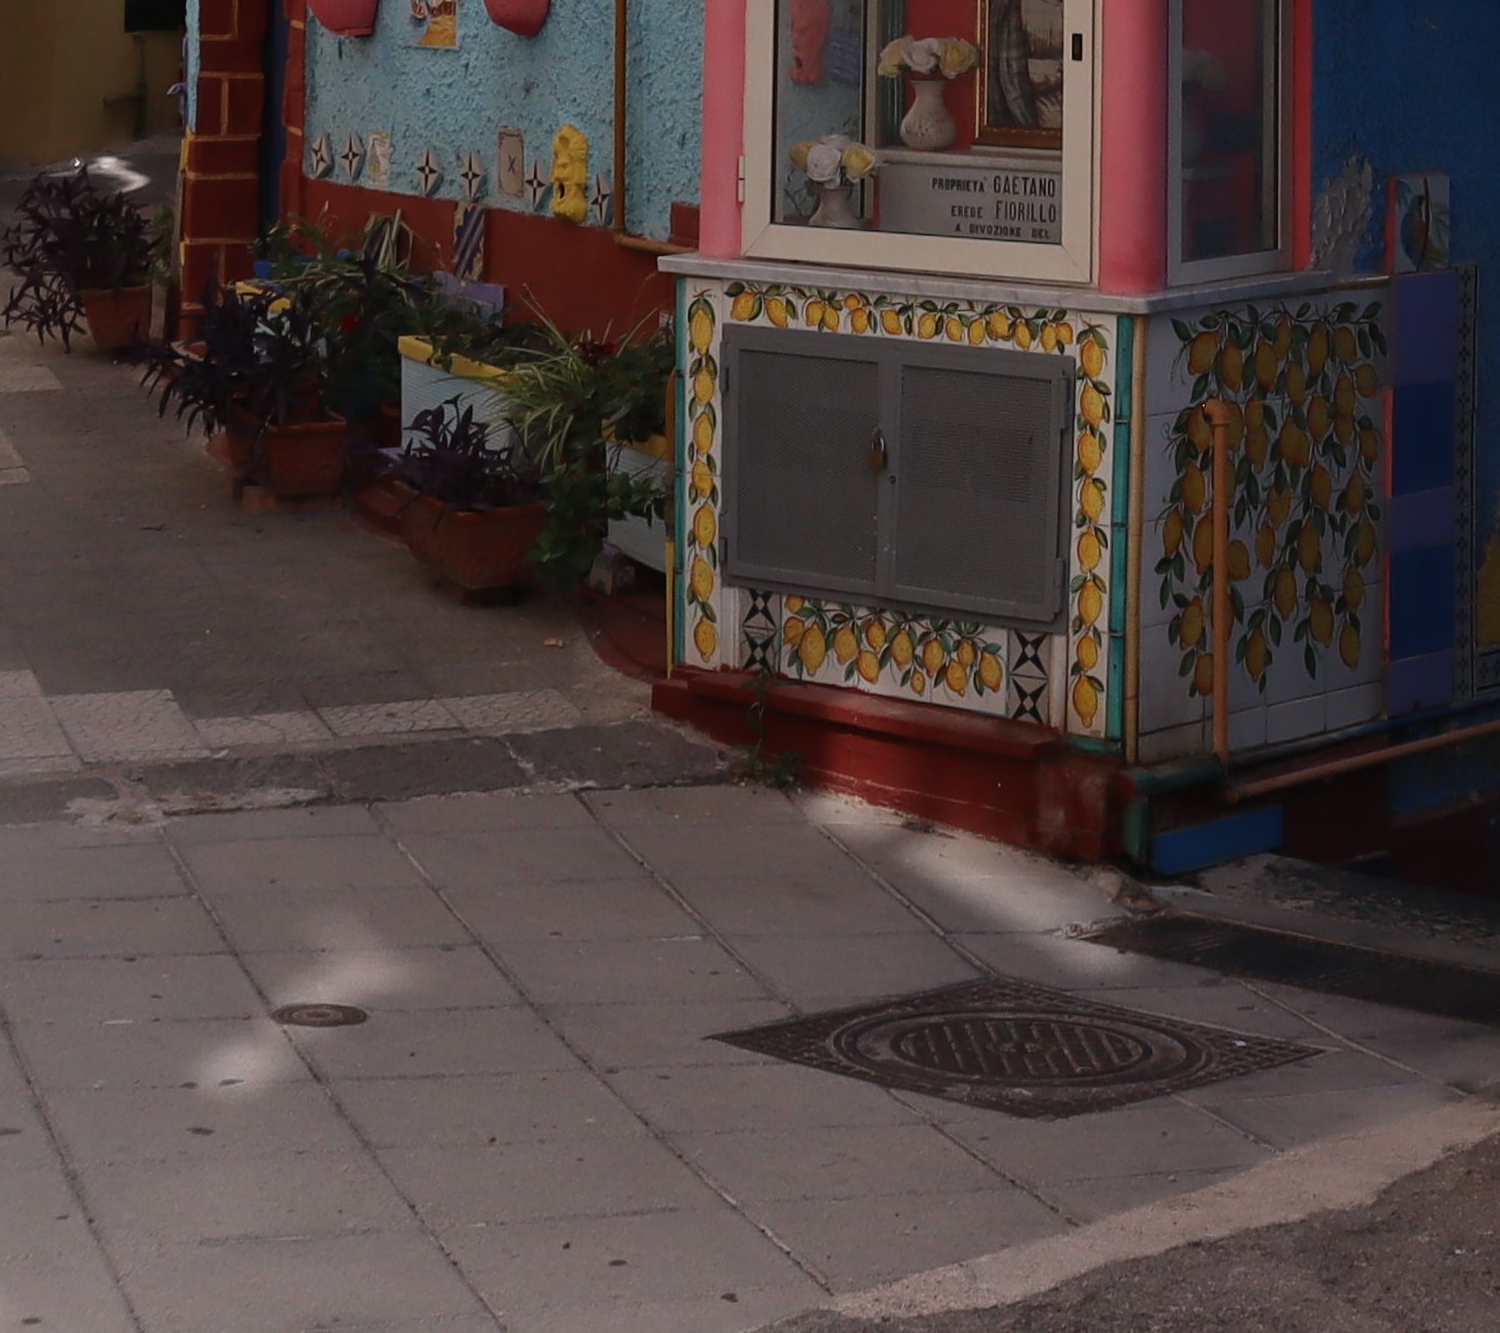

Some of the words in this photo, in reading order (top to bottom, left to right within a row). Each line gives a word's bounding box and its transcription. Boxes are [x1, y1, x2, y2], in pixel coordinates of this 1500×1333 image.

[993, 175, 1056, 198] GAETANO
[995, 200, 1056, 223] FIORILLO
[955, 222, 961, 233] A
[969, 223, 1021, 237] DIVOZIONE
[1031, 228, 1050, 240] DEL
